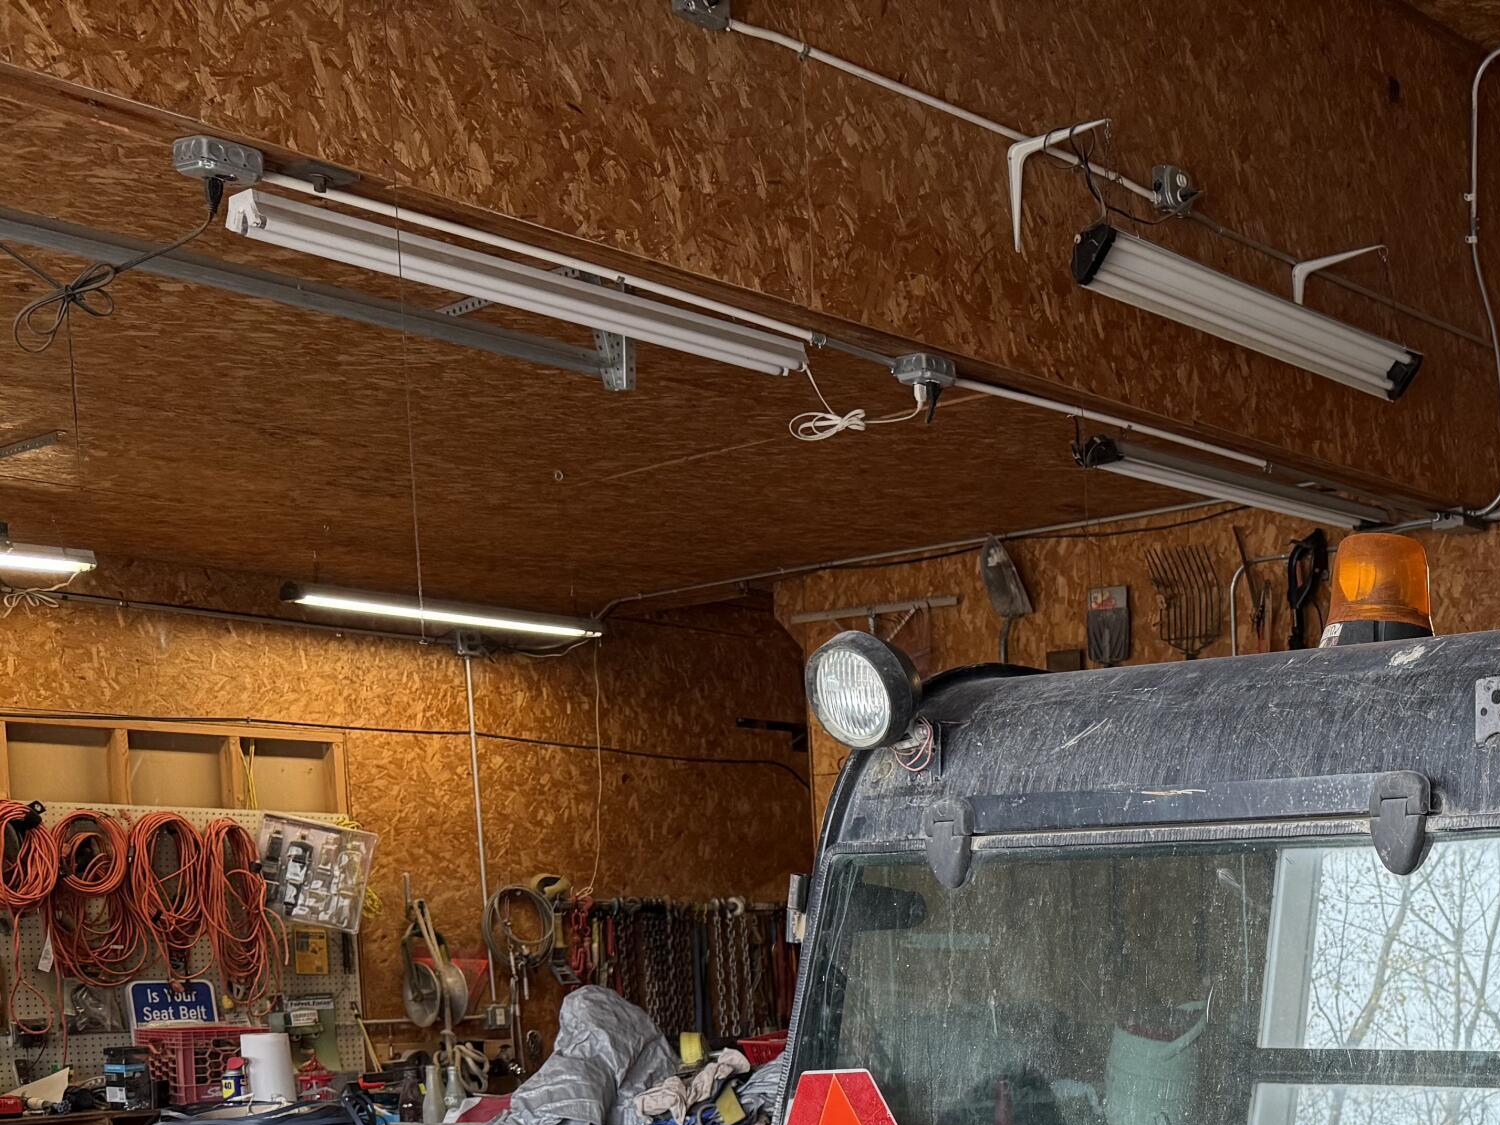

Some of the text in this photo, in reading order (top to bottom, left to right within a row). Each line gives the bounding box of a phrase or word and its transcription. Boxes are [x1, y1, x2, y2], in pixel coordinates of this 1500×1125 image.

[147, 987, 197, 1003] Is Your
[143, 1005, 208, 1021] Seat Belt
